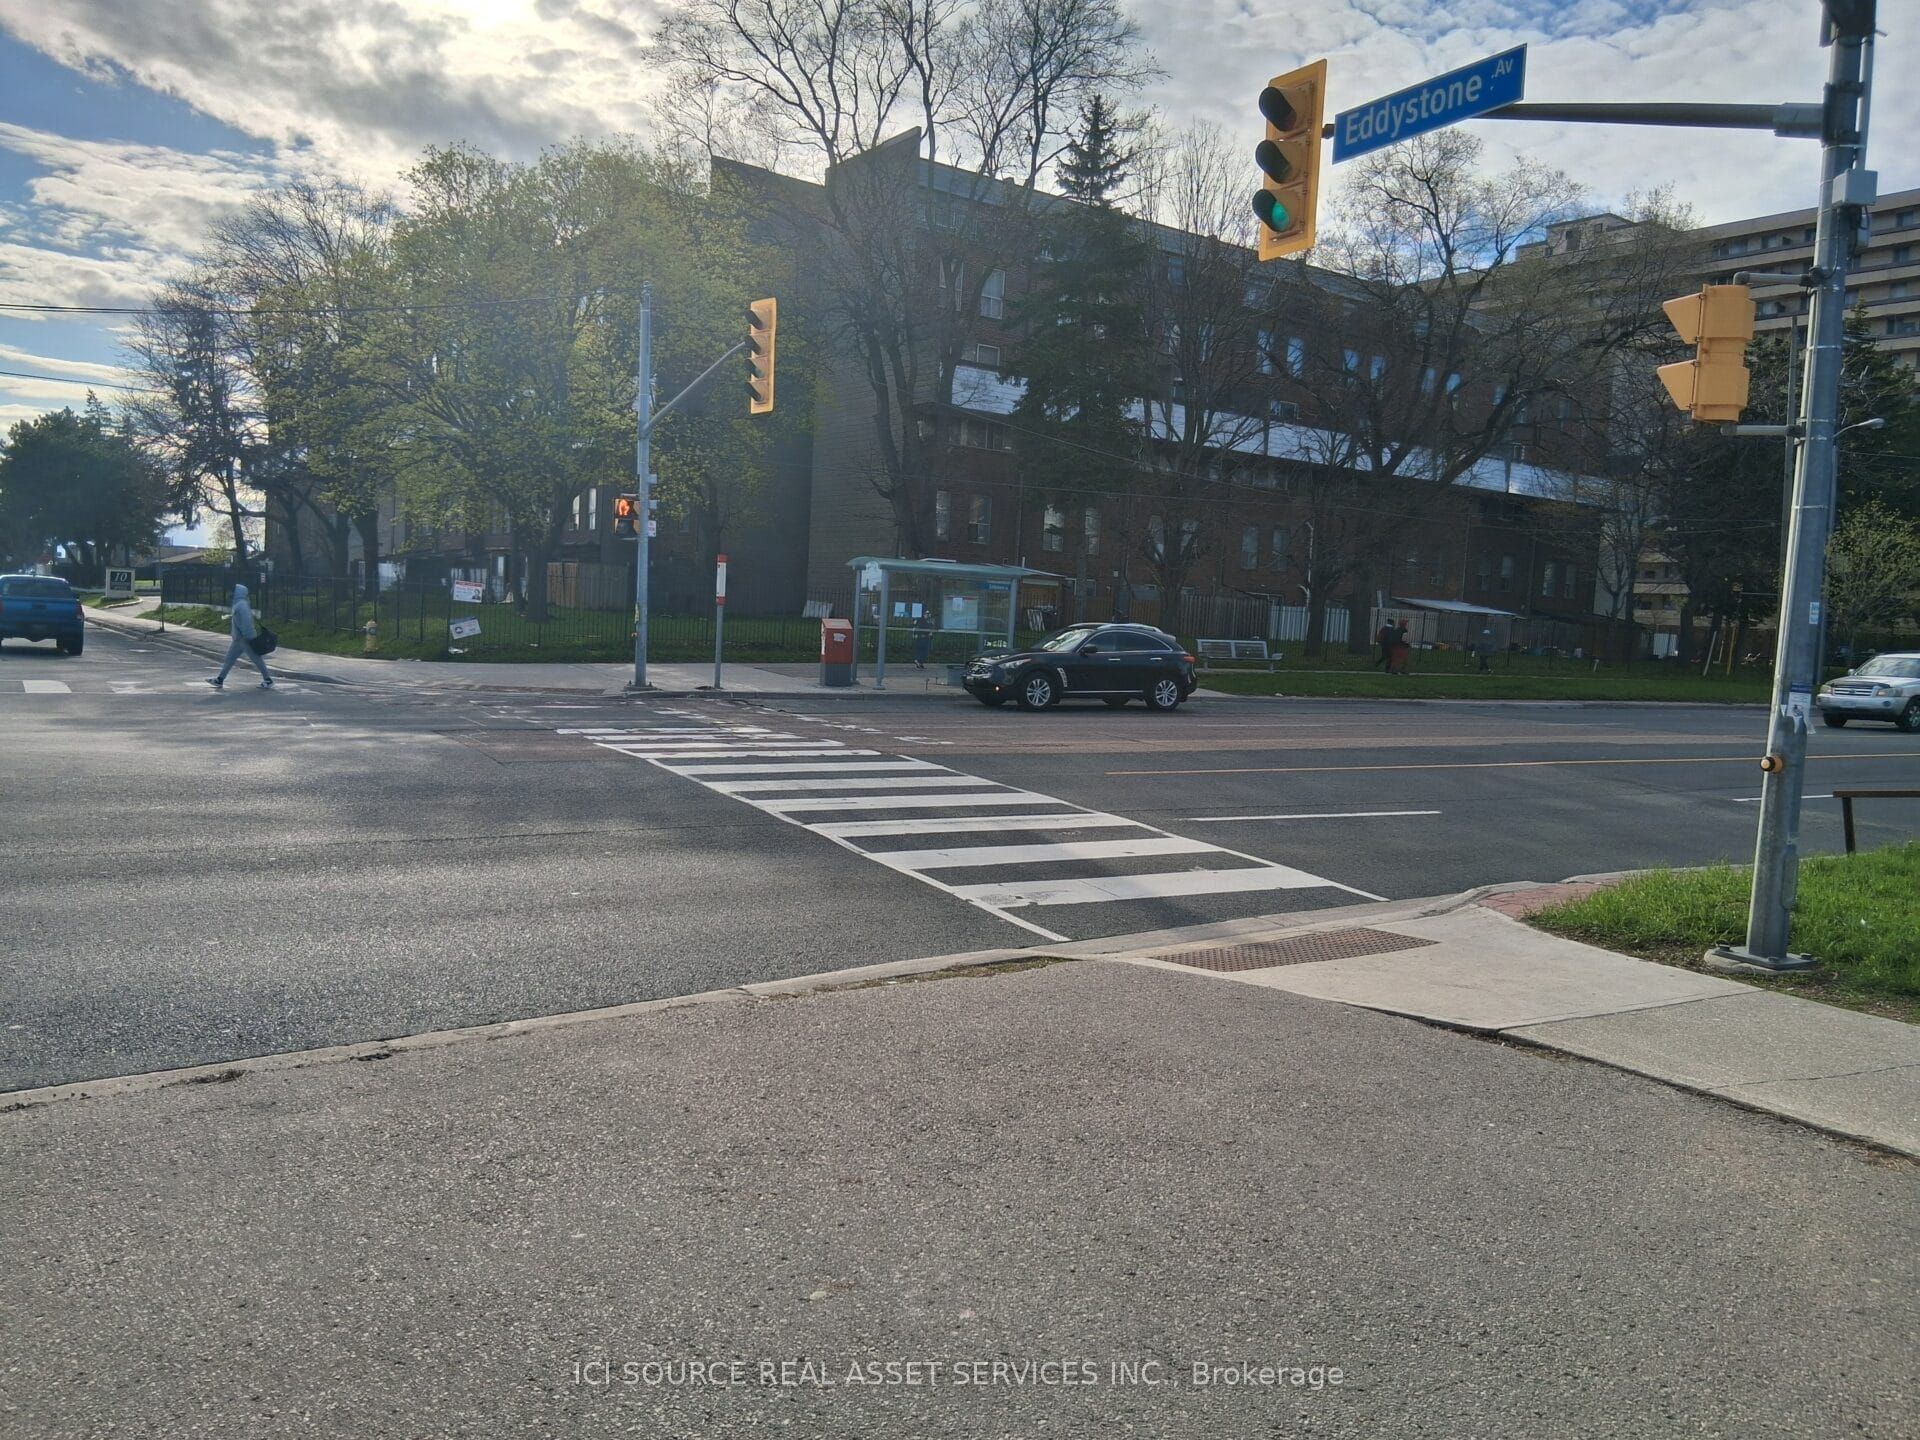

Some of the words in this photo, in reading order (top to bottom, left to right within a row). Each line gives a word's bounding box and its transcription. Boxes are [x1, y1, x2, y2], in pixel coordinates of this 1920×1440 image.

[1345, 74, 1482, 145] Eddystone
[1494, 58, 1514, 78] Av
[114, 572, 128, 582] 10
